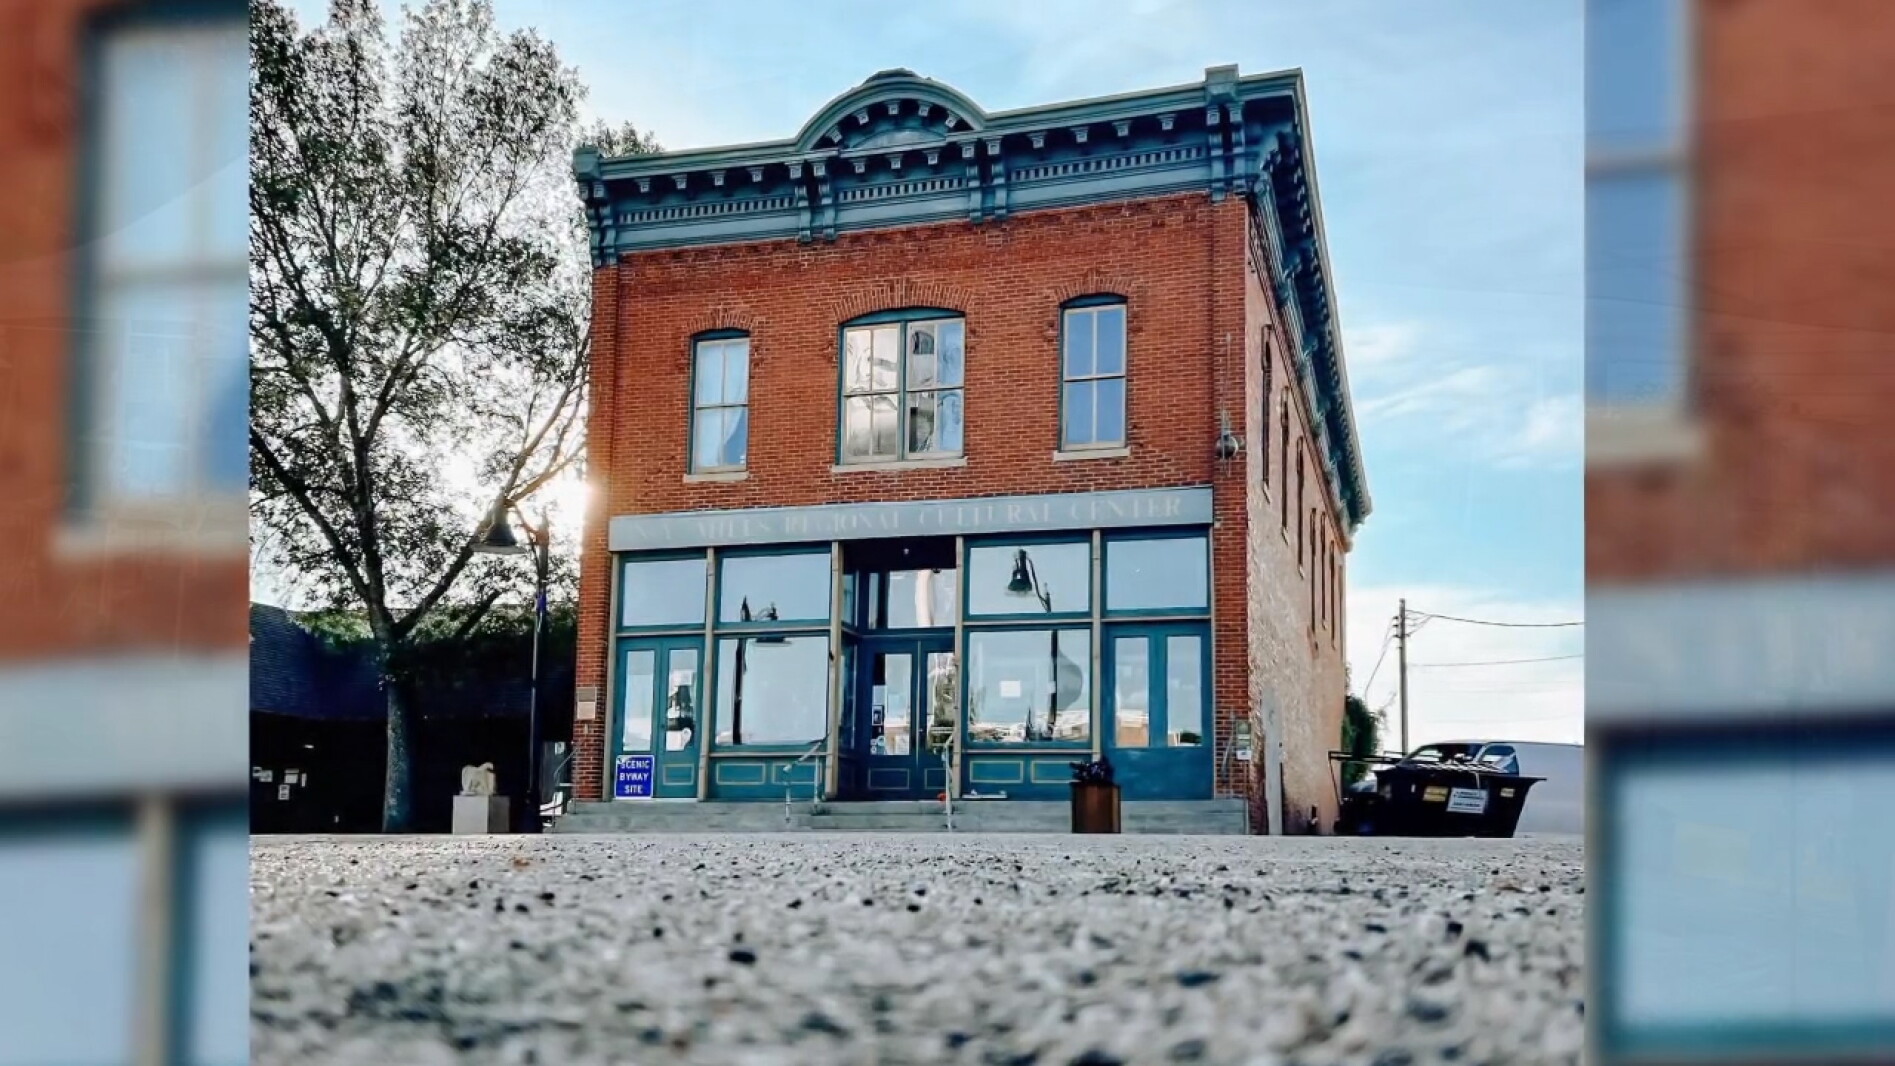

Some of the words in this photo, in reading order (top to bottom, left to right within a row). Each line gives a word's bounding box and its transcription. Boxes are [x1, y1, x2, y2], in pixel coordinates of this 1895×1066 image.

[784, 511, 902, 535] REGIONAL
[918, 502, 1053, 527] CULTURAL
[1070, 497, 1183, 521] CENTER
[620, 760, 650, 769] SCENIC
[619, 773, 648, 781] BYWAY
[624, 785, 643, 794] SITE
